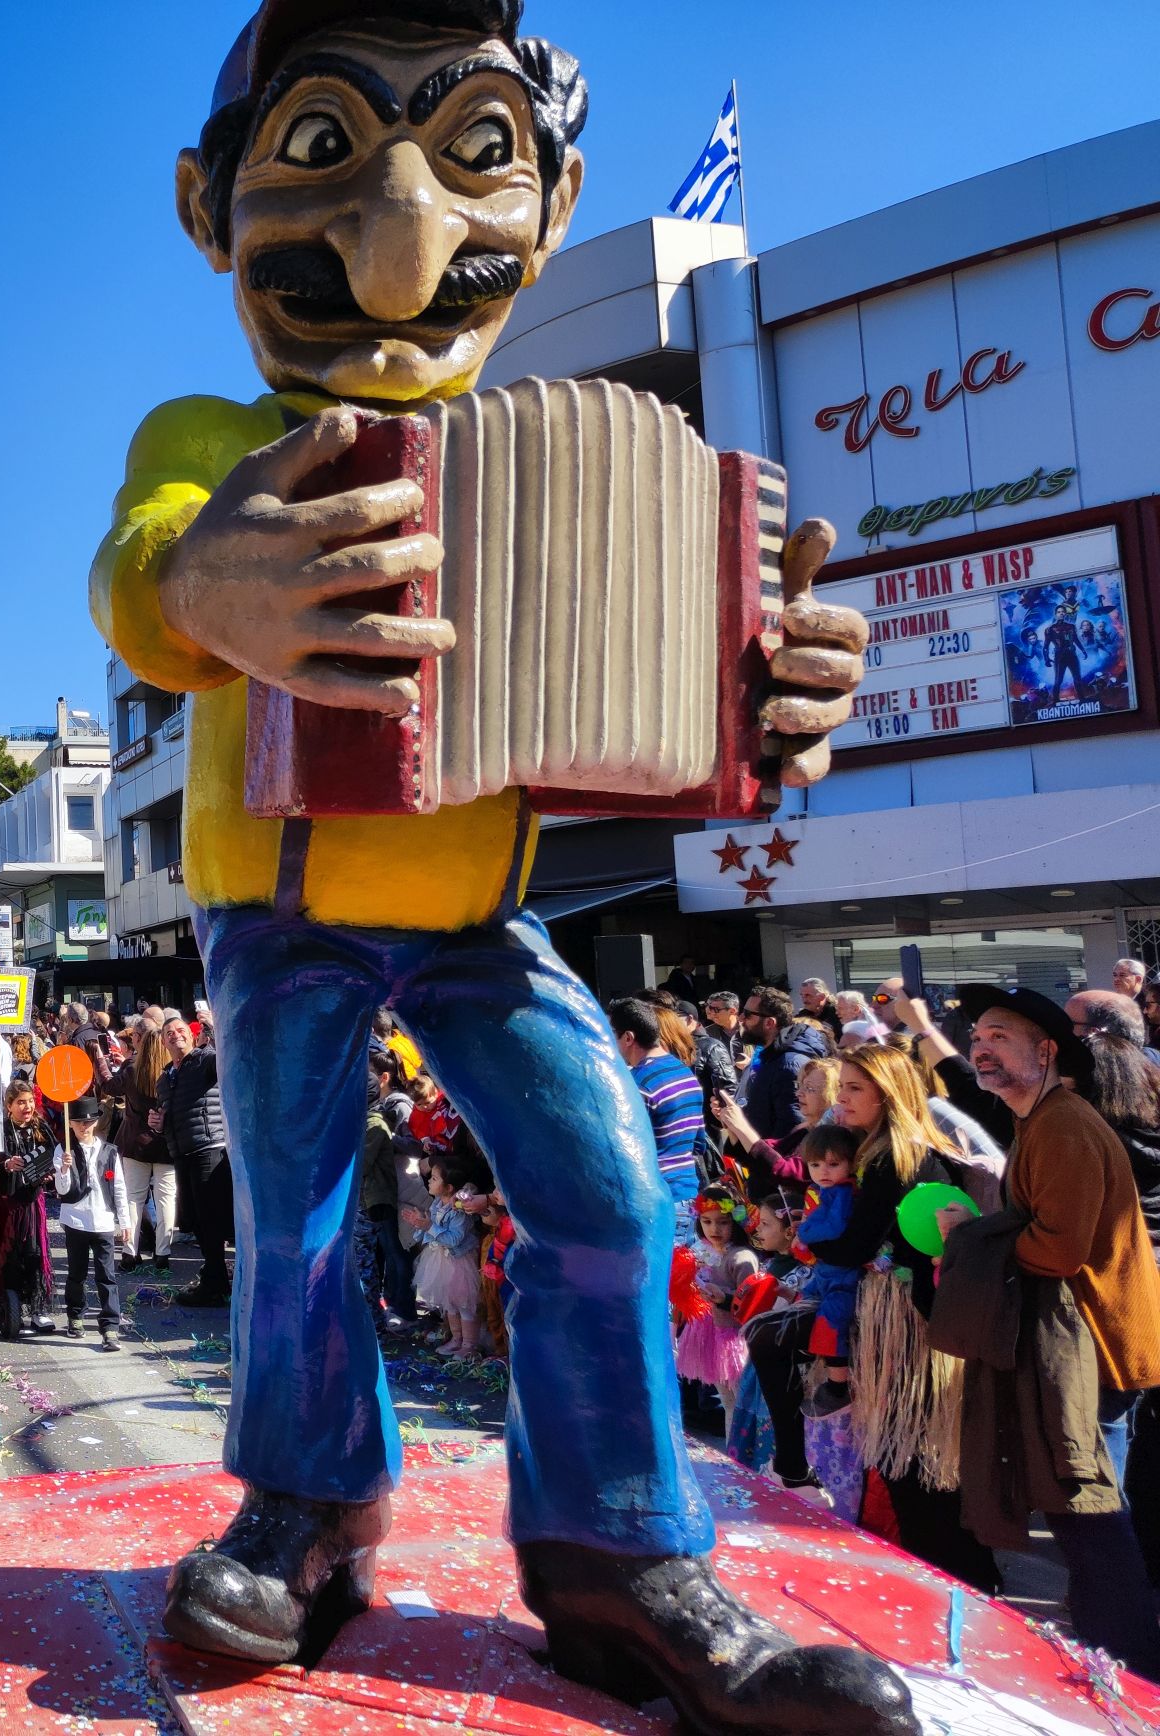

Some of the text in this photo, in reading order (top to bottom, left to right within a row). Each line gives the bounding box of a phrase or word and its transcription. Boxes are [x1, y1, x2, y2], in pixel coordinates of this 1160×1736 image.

[875, 547, 1034, 607] ANT-MAN & WASP
[928, 632, 970, 657] 22:30
[849, 690, 900, 718] ΣΤΕΡΙΞ
[909, 687, 918, 710] &
[866, 713, 909, 739] 18:00
